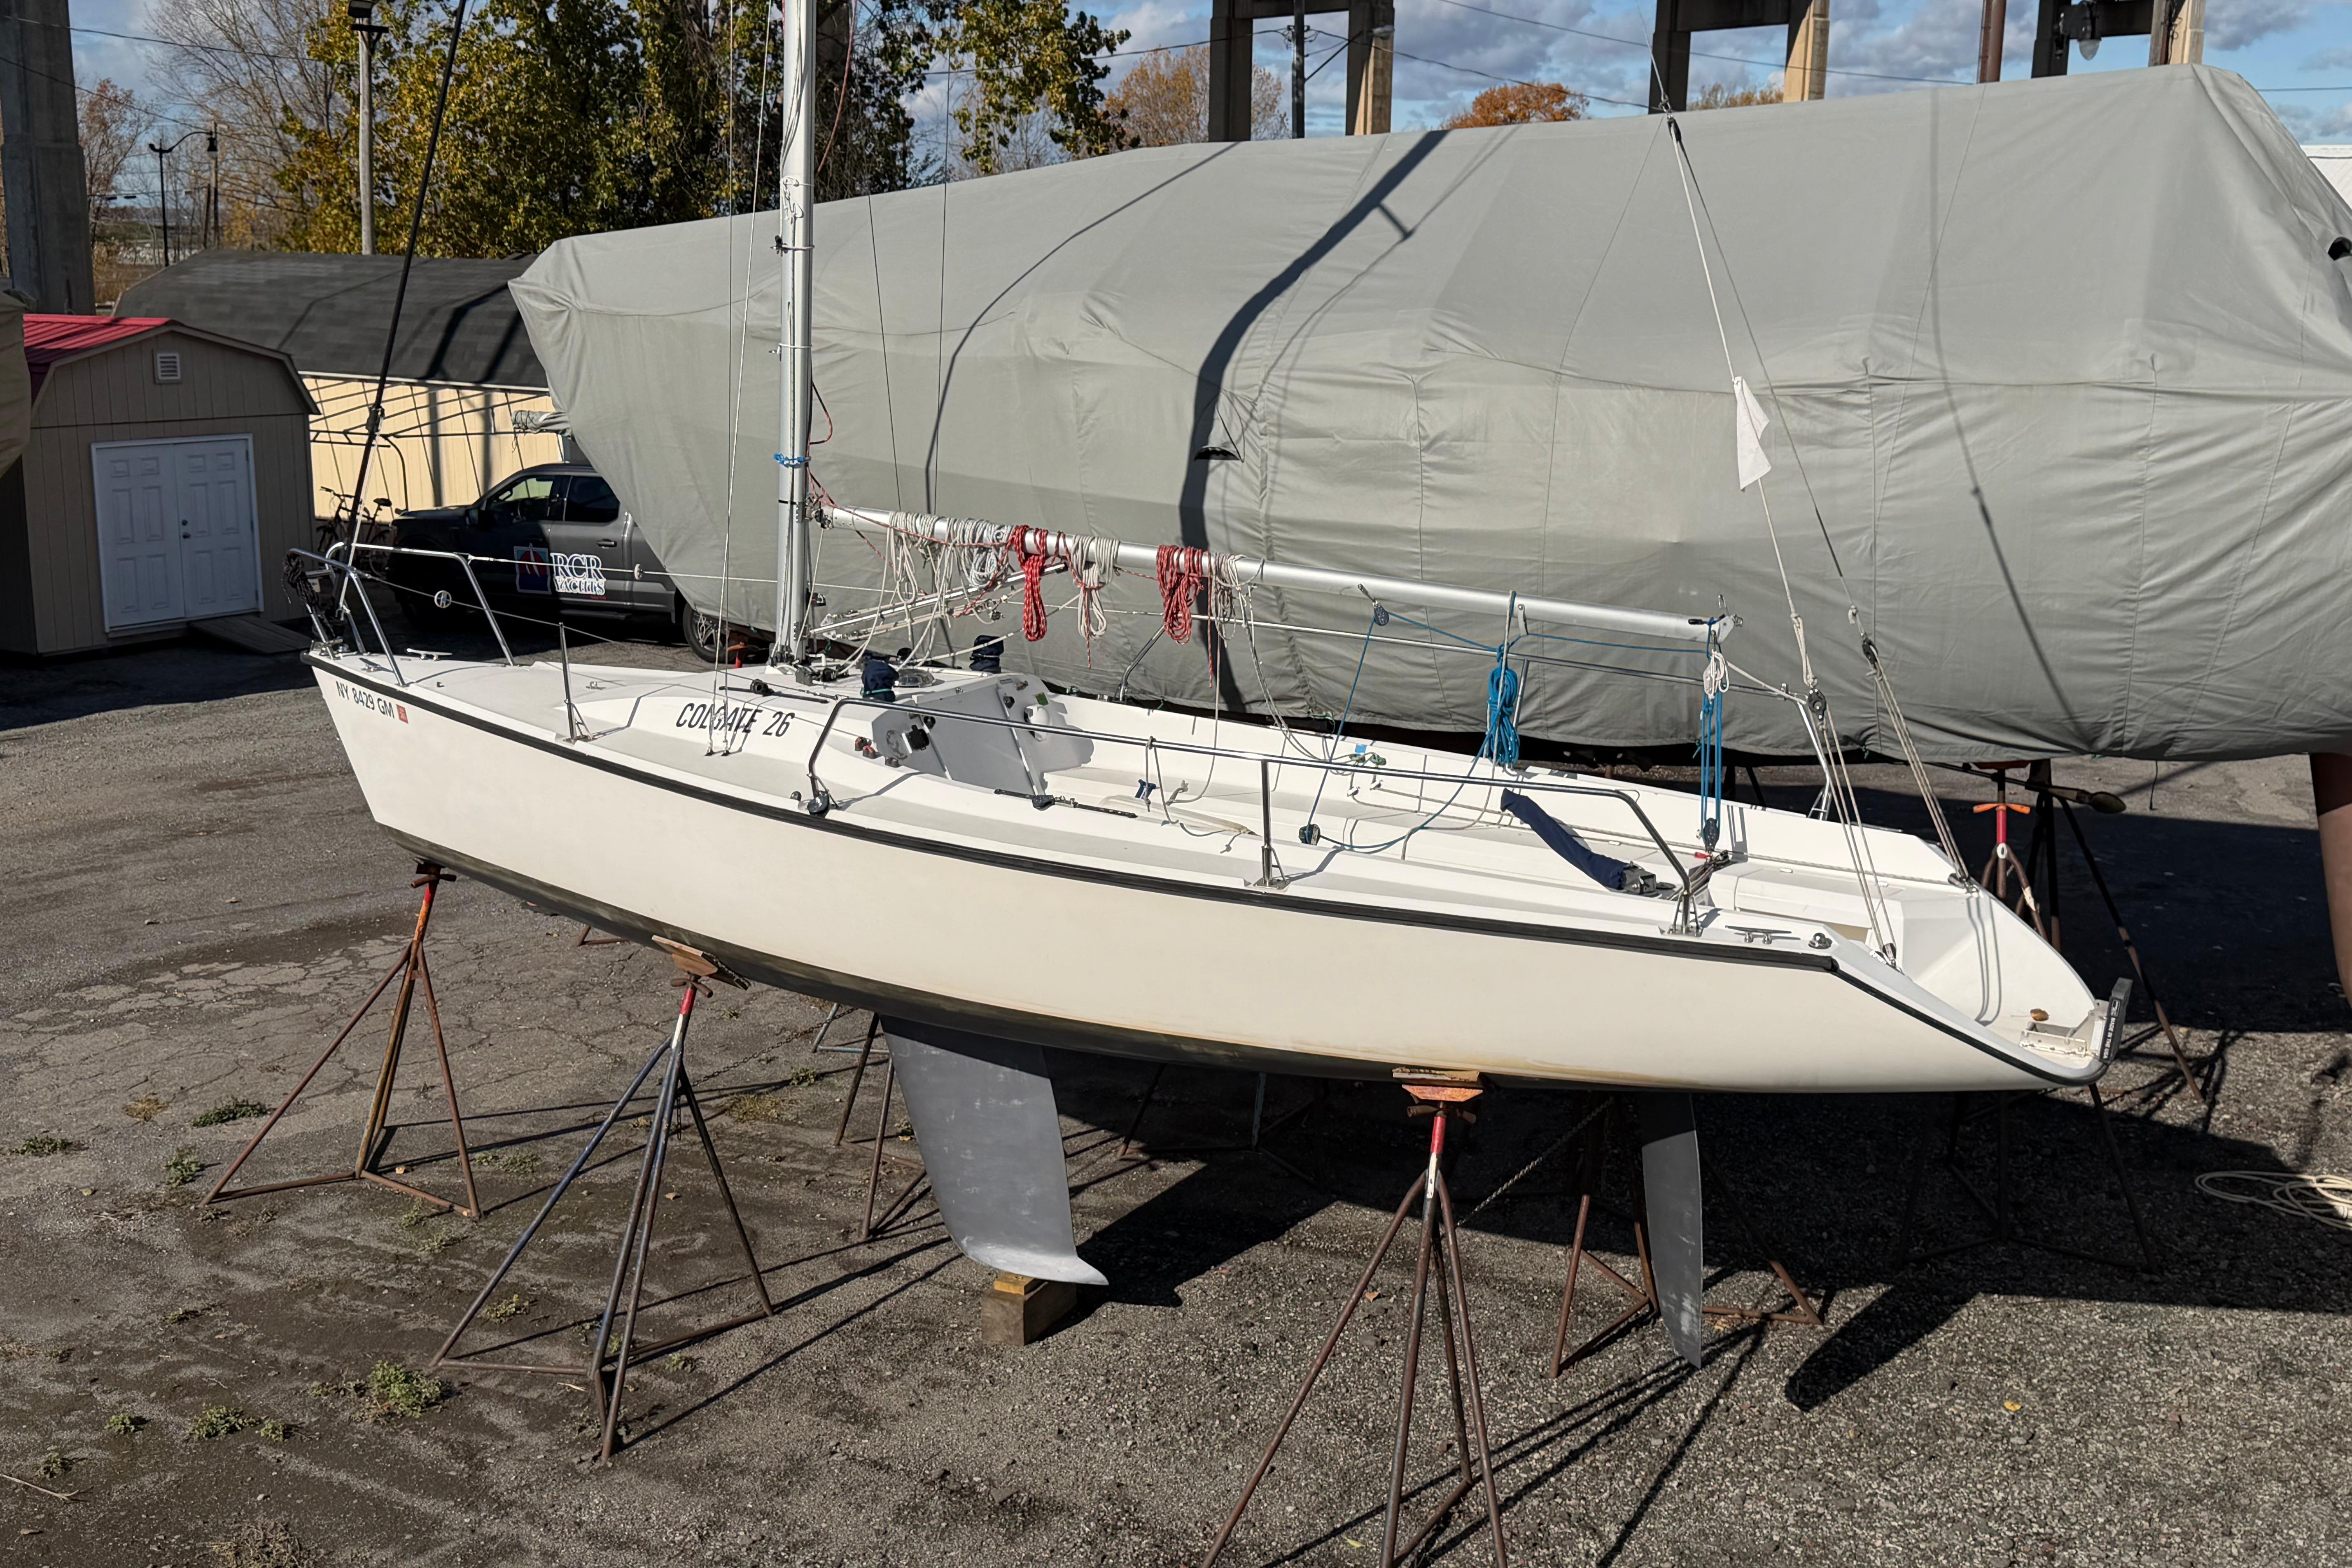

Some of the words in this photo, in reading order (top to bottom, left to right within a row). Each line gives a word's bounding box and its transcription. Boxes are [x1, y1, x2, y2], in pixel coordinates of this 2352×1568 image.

[550, 553, 606, 581] RCR
[553, 577, 605, 595] YACHTS
[336, 680, 349, 700] NY
[352, 687, 375, 710] 8429
[377, 698, 394, 719] GM
[762, 711, 795, 737] 26
